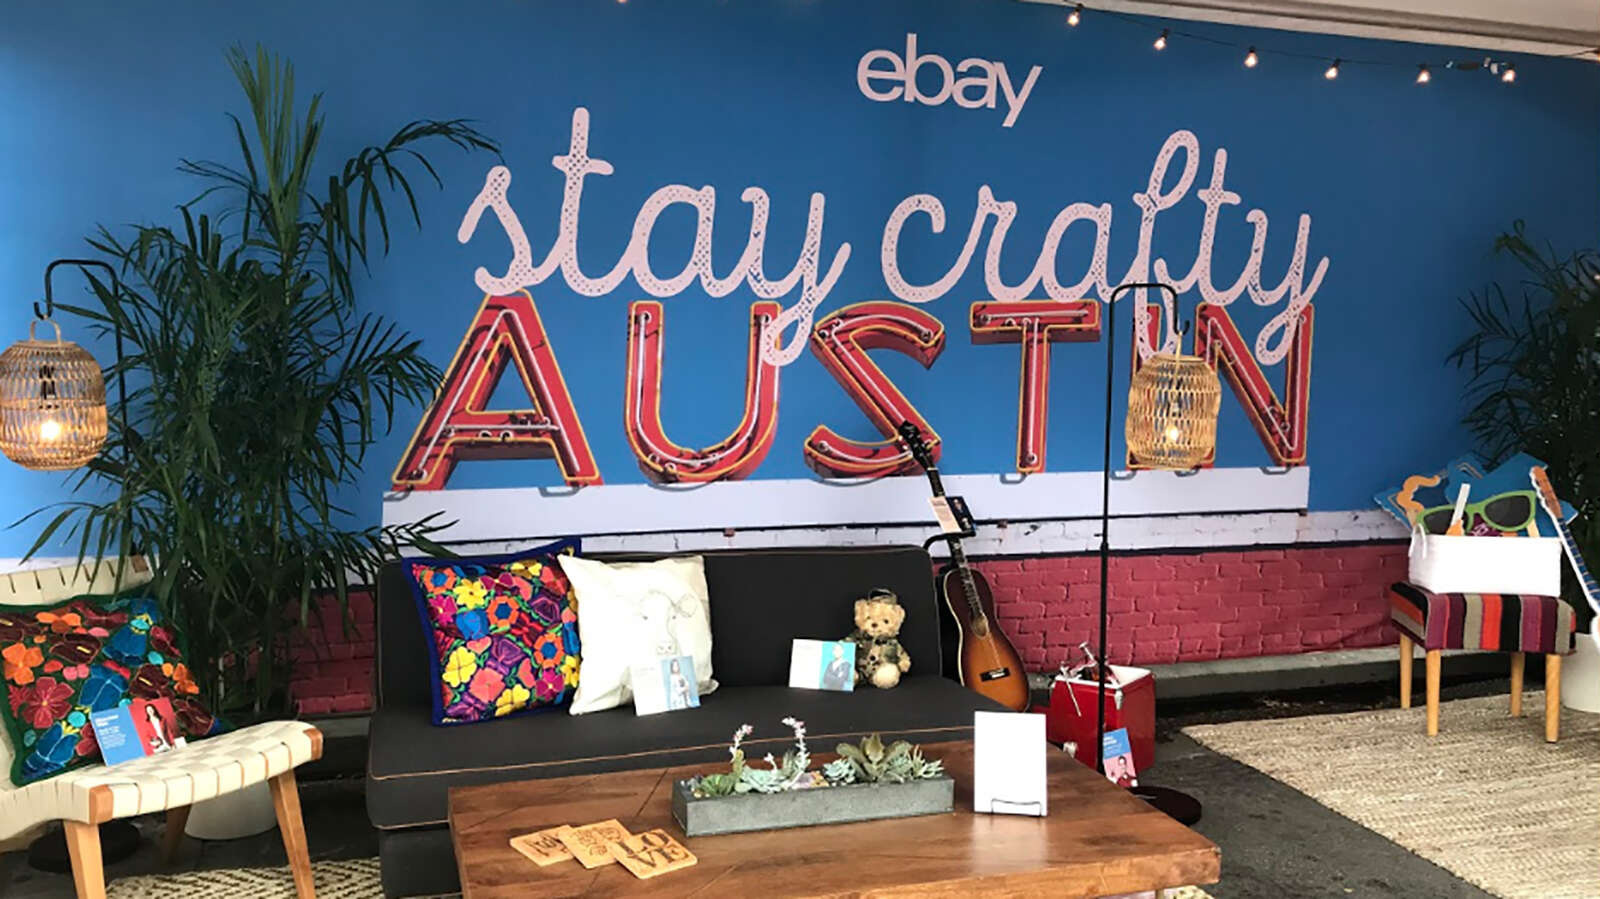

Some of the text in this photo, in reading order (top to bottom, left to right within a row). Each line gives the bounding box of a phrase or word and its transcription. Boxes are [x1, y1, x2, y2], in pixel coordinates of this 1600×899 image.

[857, 33, 1043, 127] ebay
[458, 107, 1330, 366] stay crafty
